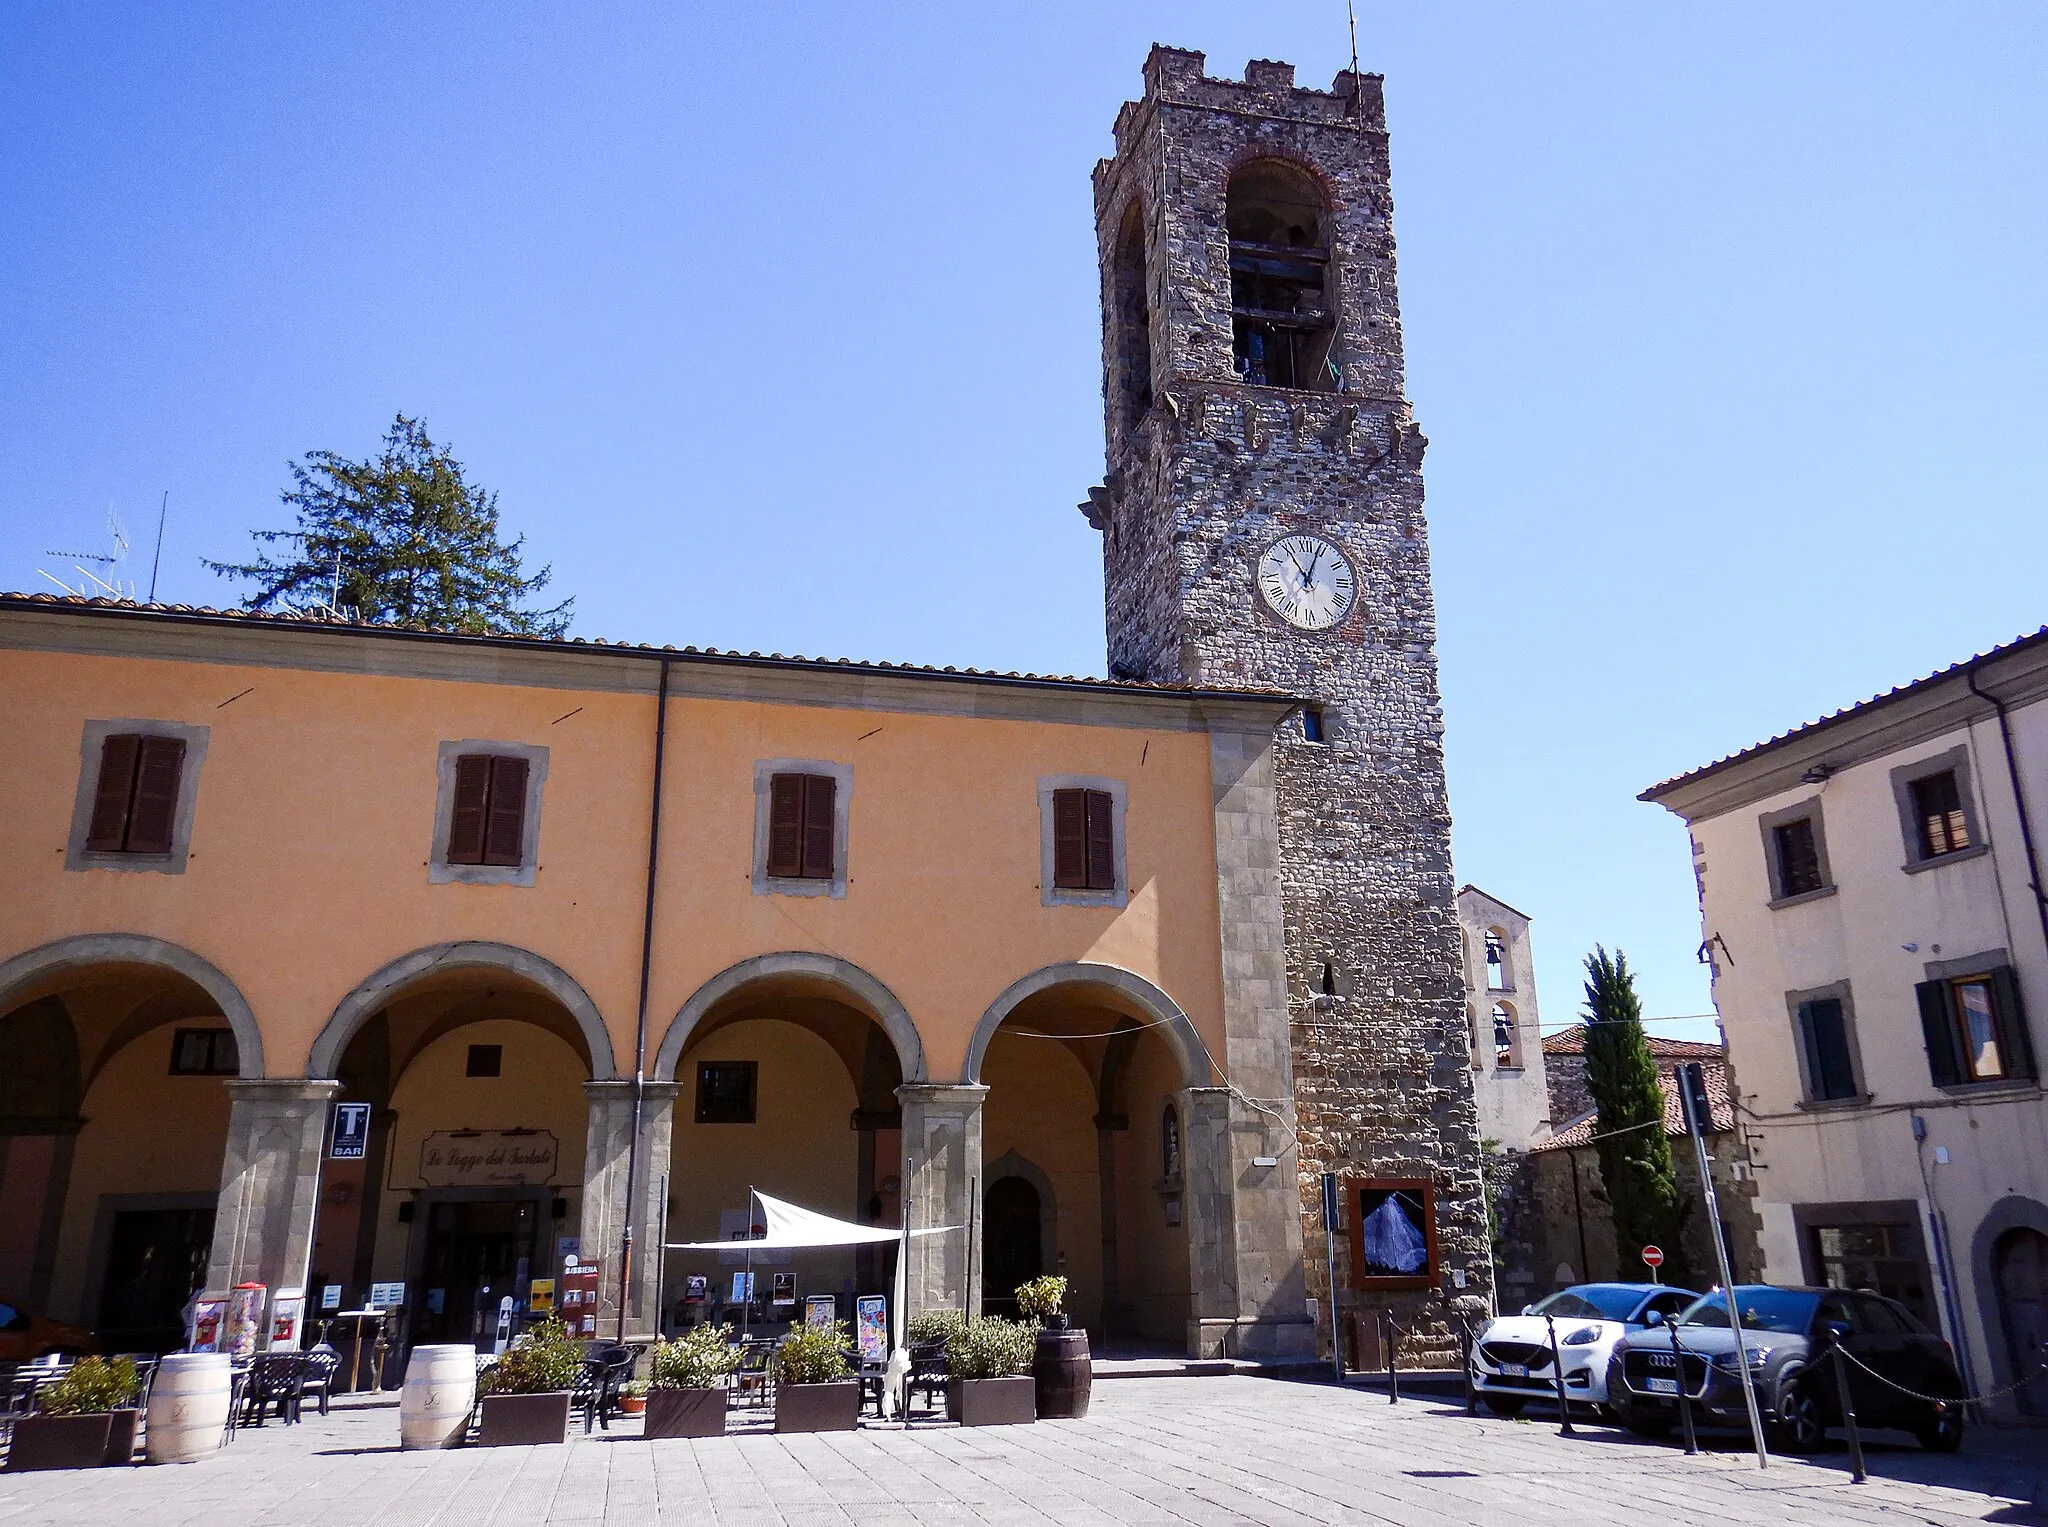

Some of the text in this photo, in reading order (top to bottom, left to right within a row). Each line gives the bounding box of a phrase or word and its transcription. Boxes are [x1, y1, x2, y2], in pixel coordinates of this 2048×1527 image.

[1298, 540, 1313, 553] XII
[1330, 561, 1343, 571] II
[1336, 578, 1349, 588] III
[1331, 592, 1347, 609] IIII
[341, 1107, 365, 1135] T
[334, 1147, 362, 1155] BAR
[734, 1232, 766, 1240] MARTI
